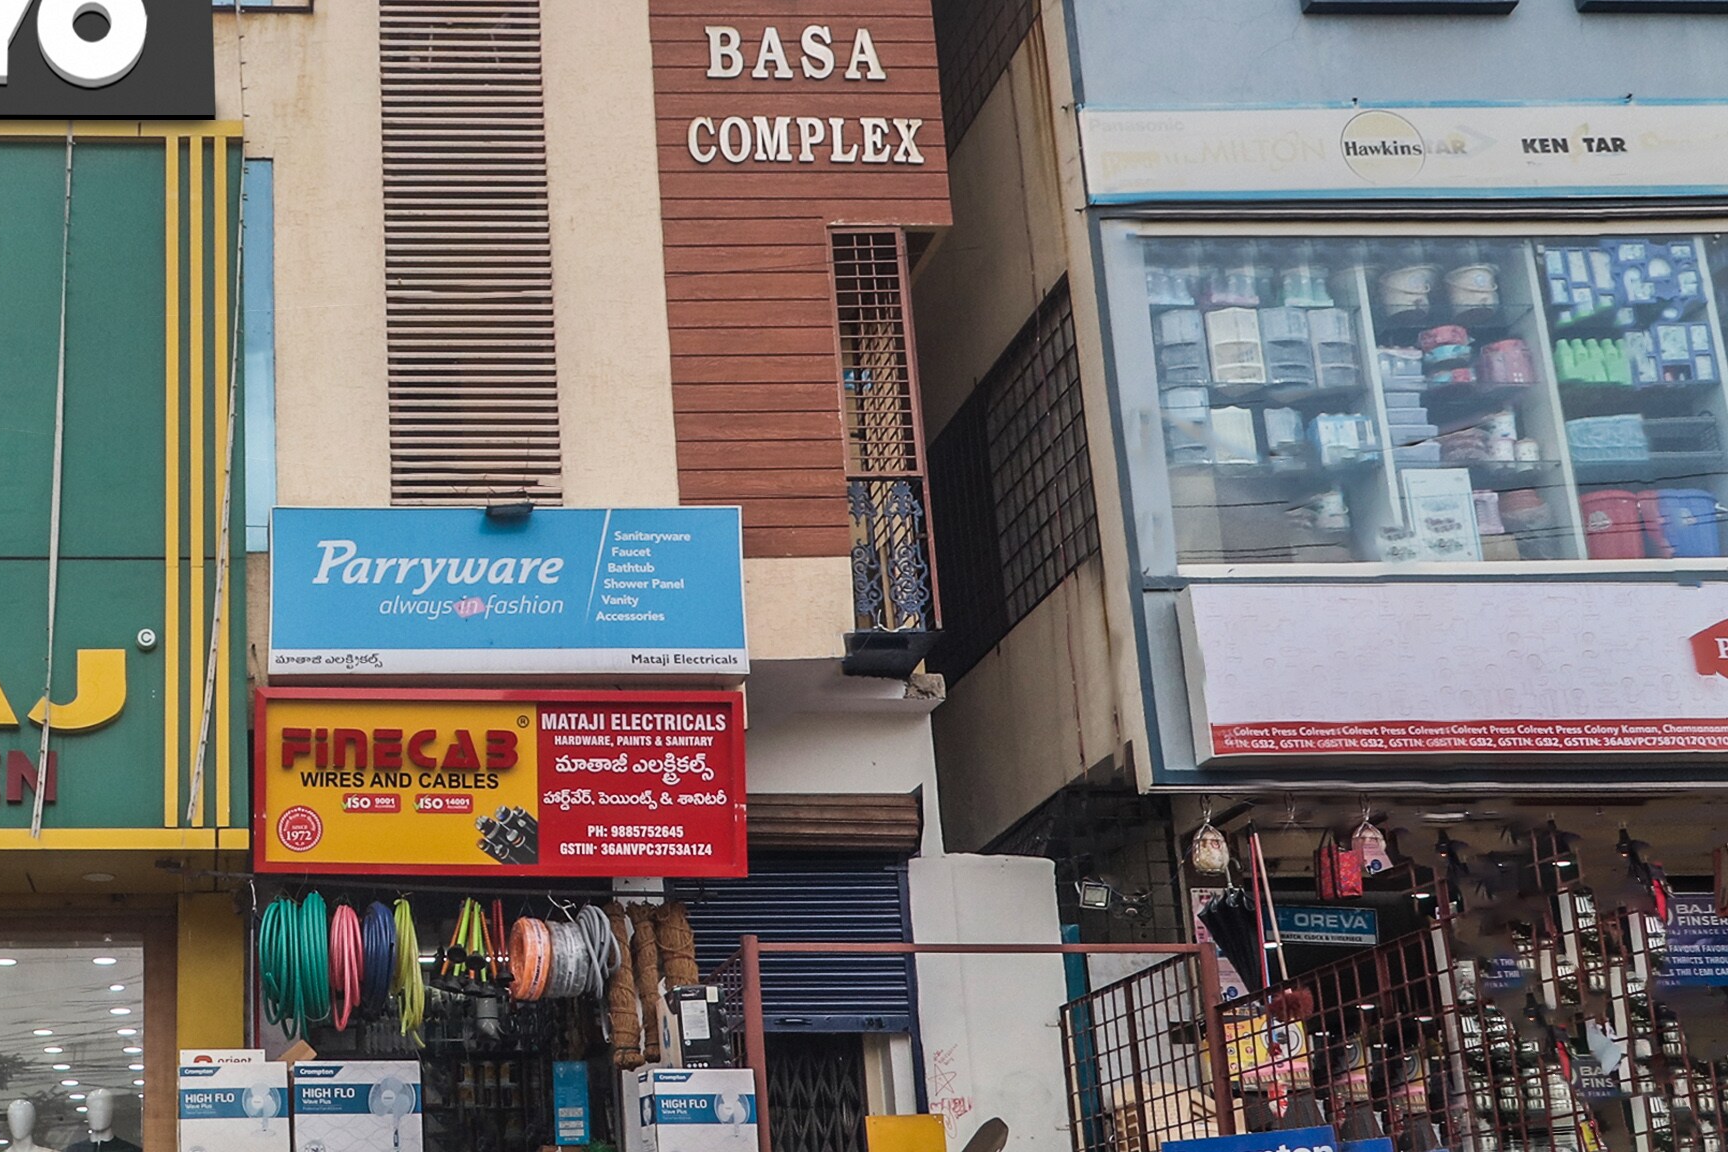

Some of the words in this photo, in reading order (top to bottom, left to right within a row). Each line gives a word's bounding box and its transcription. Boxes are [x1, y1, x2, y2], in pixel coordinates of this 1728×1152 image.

[705, 25, 887, 80] BASA
[687, 116, 925, 164] COMPLEX
[1344, 141, 1423, 157] Hawkins
[614, 530, 691, 544] Sanitaryware
[612, 546, 651, 557] Faucet
[312, 539, 564, 596] Parryware
[607, 562, 655, 573] Bathtub
[603, 578, 649, 589] Shower
[652, 578, 685, 589] Panel
[379, 595, 453, 620] always
[460, 596, 479, 614] in
[484, 594, 563, 620] fashion
[601, 594, 639, 608] Vanity
[595, 611, 665, 622] Accessories
[631, 653, 670, 666] Mataji
[673, 653, 738, 665] Electricals
[542, 713, 604, 731] MATAJI
[611, 713, 727, 731] ELECTRICALS
[281, 727, 519, 769] FINECAB
[554, 736, 614, 747] HARDWARE,
[616, 736, 652, 746] PAINTS
[655, 736, 663, 746] &
[665, 736, 714, 747] SANITARY
[300, 772, 365, 788] WIRES
[370, 772, 412, 788] AND
[418, 772, 500, 790] CABLES
[347, 796, 371, 810] ISO
[374, 797, 395, 806] 9001
[420, 796, 444, 810] ISO
[445, 797, 470, 806] 14001
[286, 831, 312, 841] 1972
[587, 826, 608, 838] PH:
[610, 826, 684, 838] 9885752645
[1293, 913, 1368, 929] OREVA
[184, 1068, 214, 1076] Crompton
[300, 1067, 335, 1077] Crompton
[658, 1074, 687, 1082] Crompton
[185, 1094, 211, 1103] HIGH
[215, 1093, 235, 1103] FLO
[302, 1088, 332, 1098] HIGH
[336, 1088, 355, 1098] FLO
[661, 1099, 686, 1109] HIGH
[689, 1099, 708, 1109] FLO
